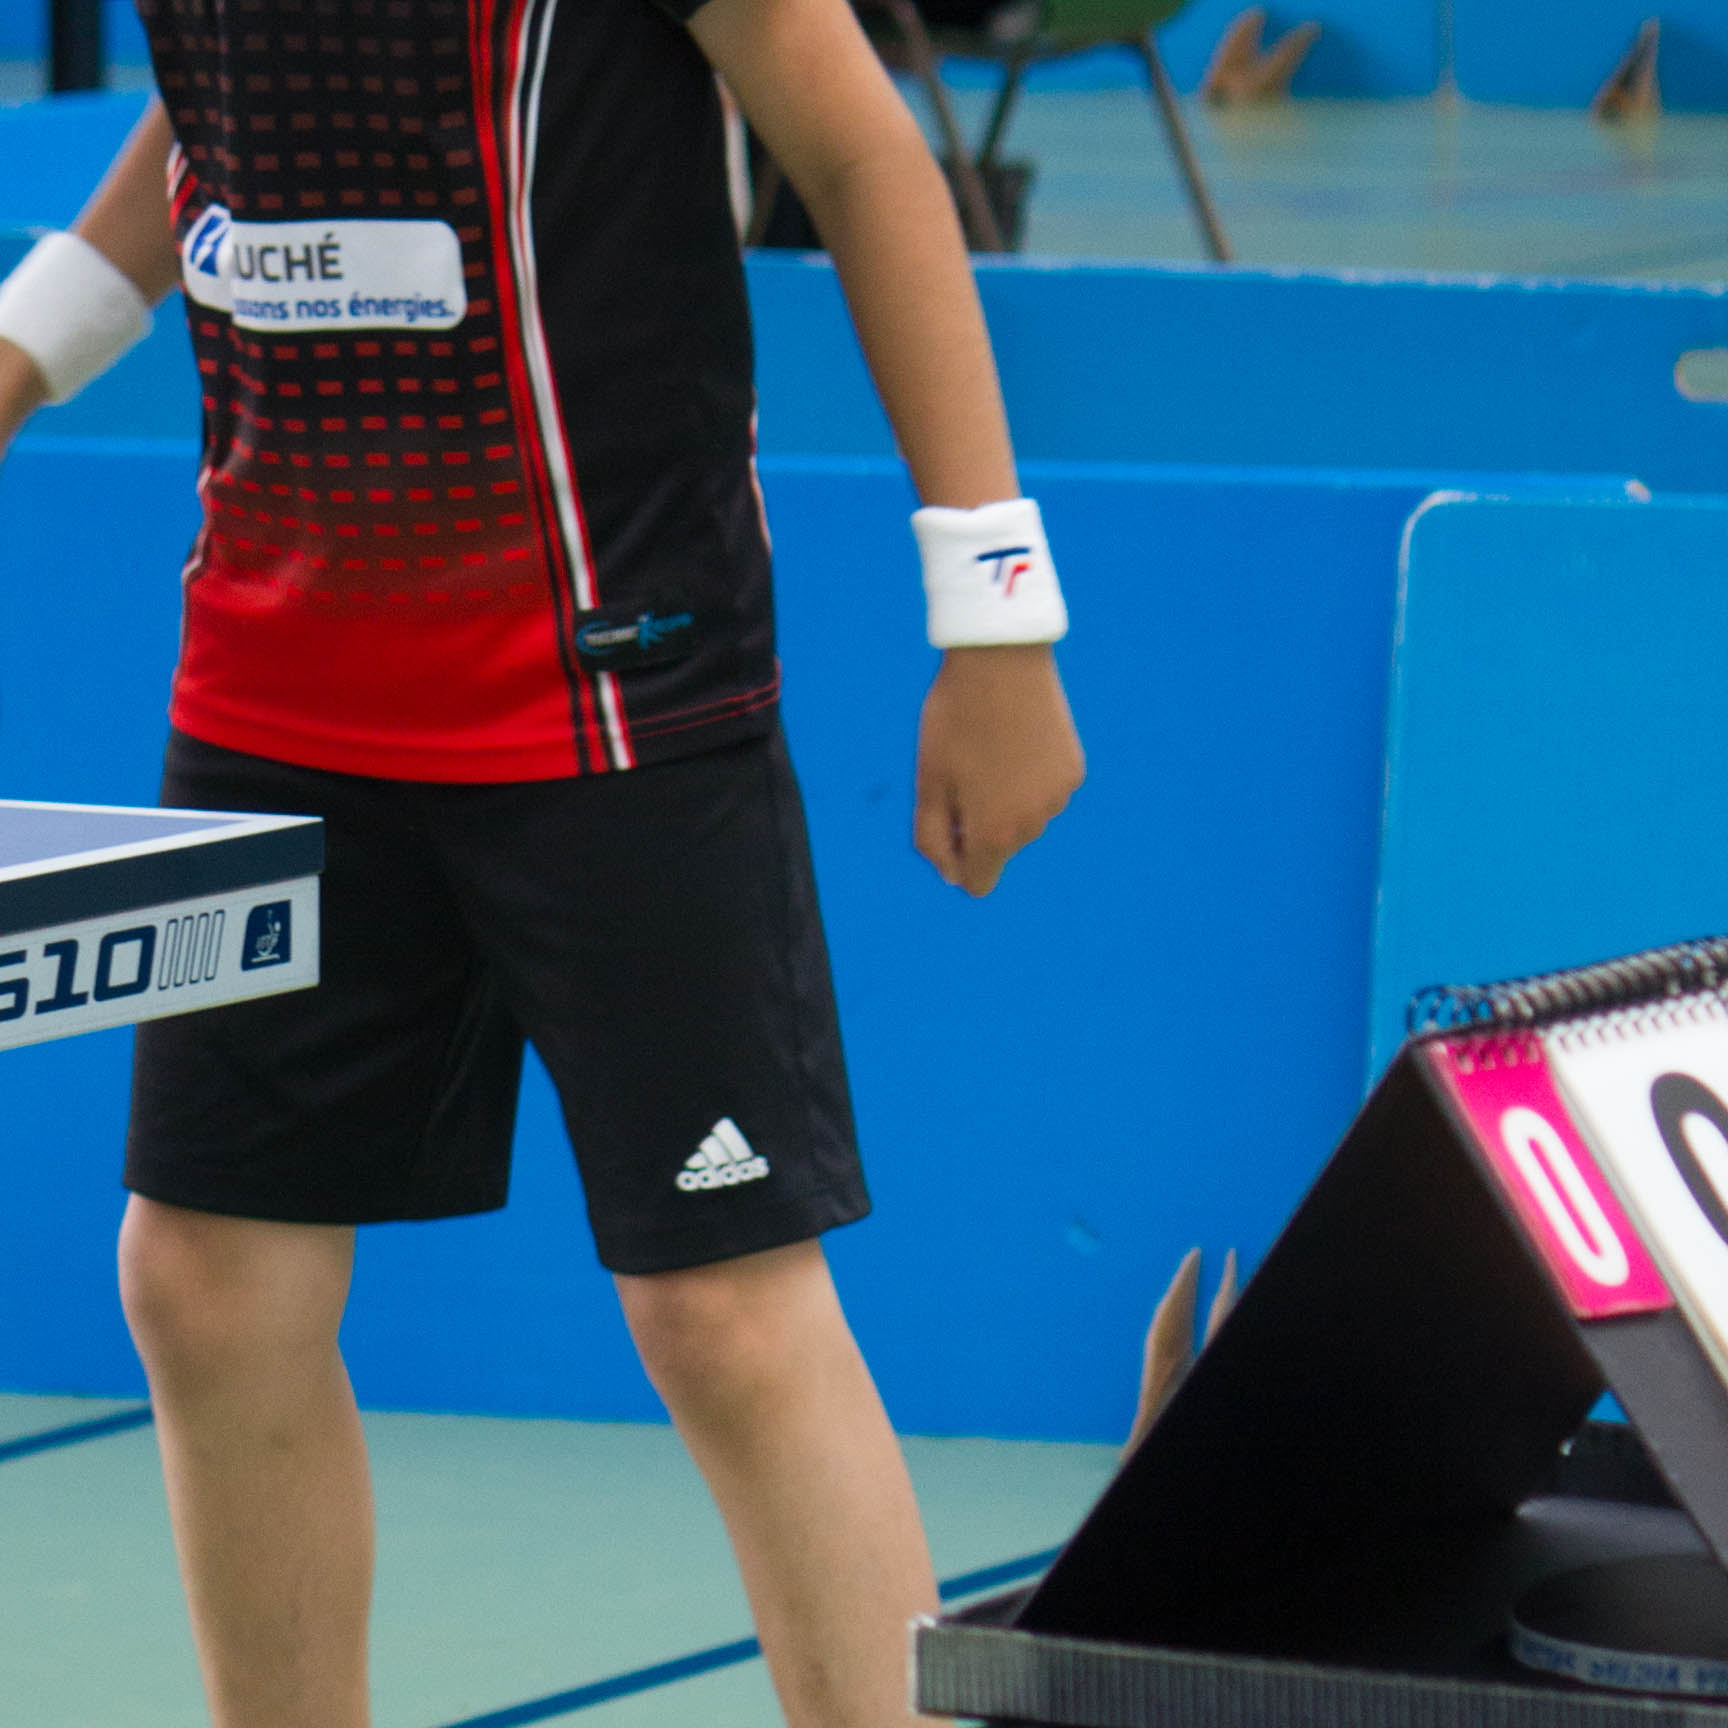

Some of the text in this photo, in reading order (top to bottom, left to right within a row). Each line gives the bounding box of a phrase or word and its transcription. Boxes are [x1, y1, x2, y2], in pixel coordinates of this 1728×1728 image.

[234, 232, 344, 282] UCHÉ
[295, 298, 342, 319] nos
[1502, 1106, 1630, 1287] 0
